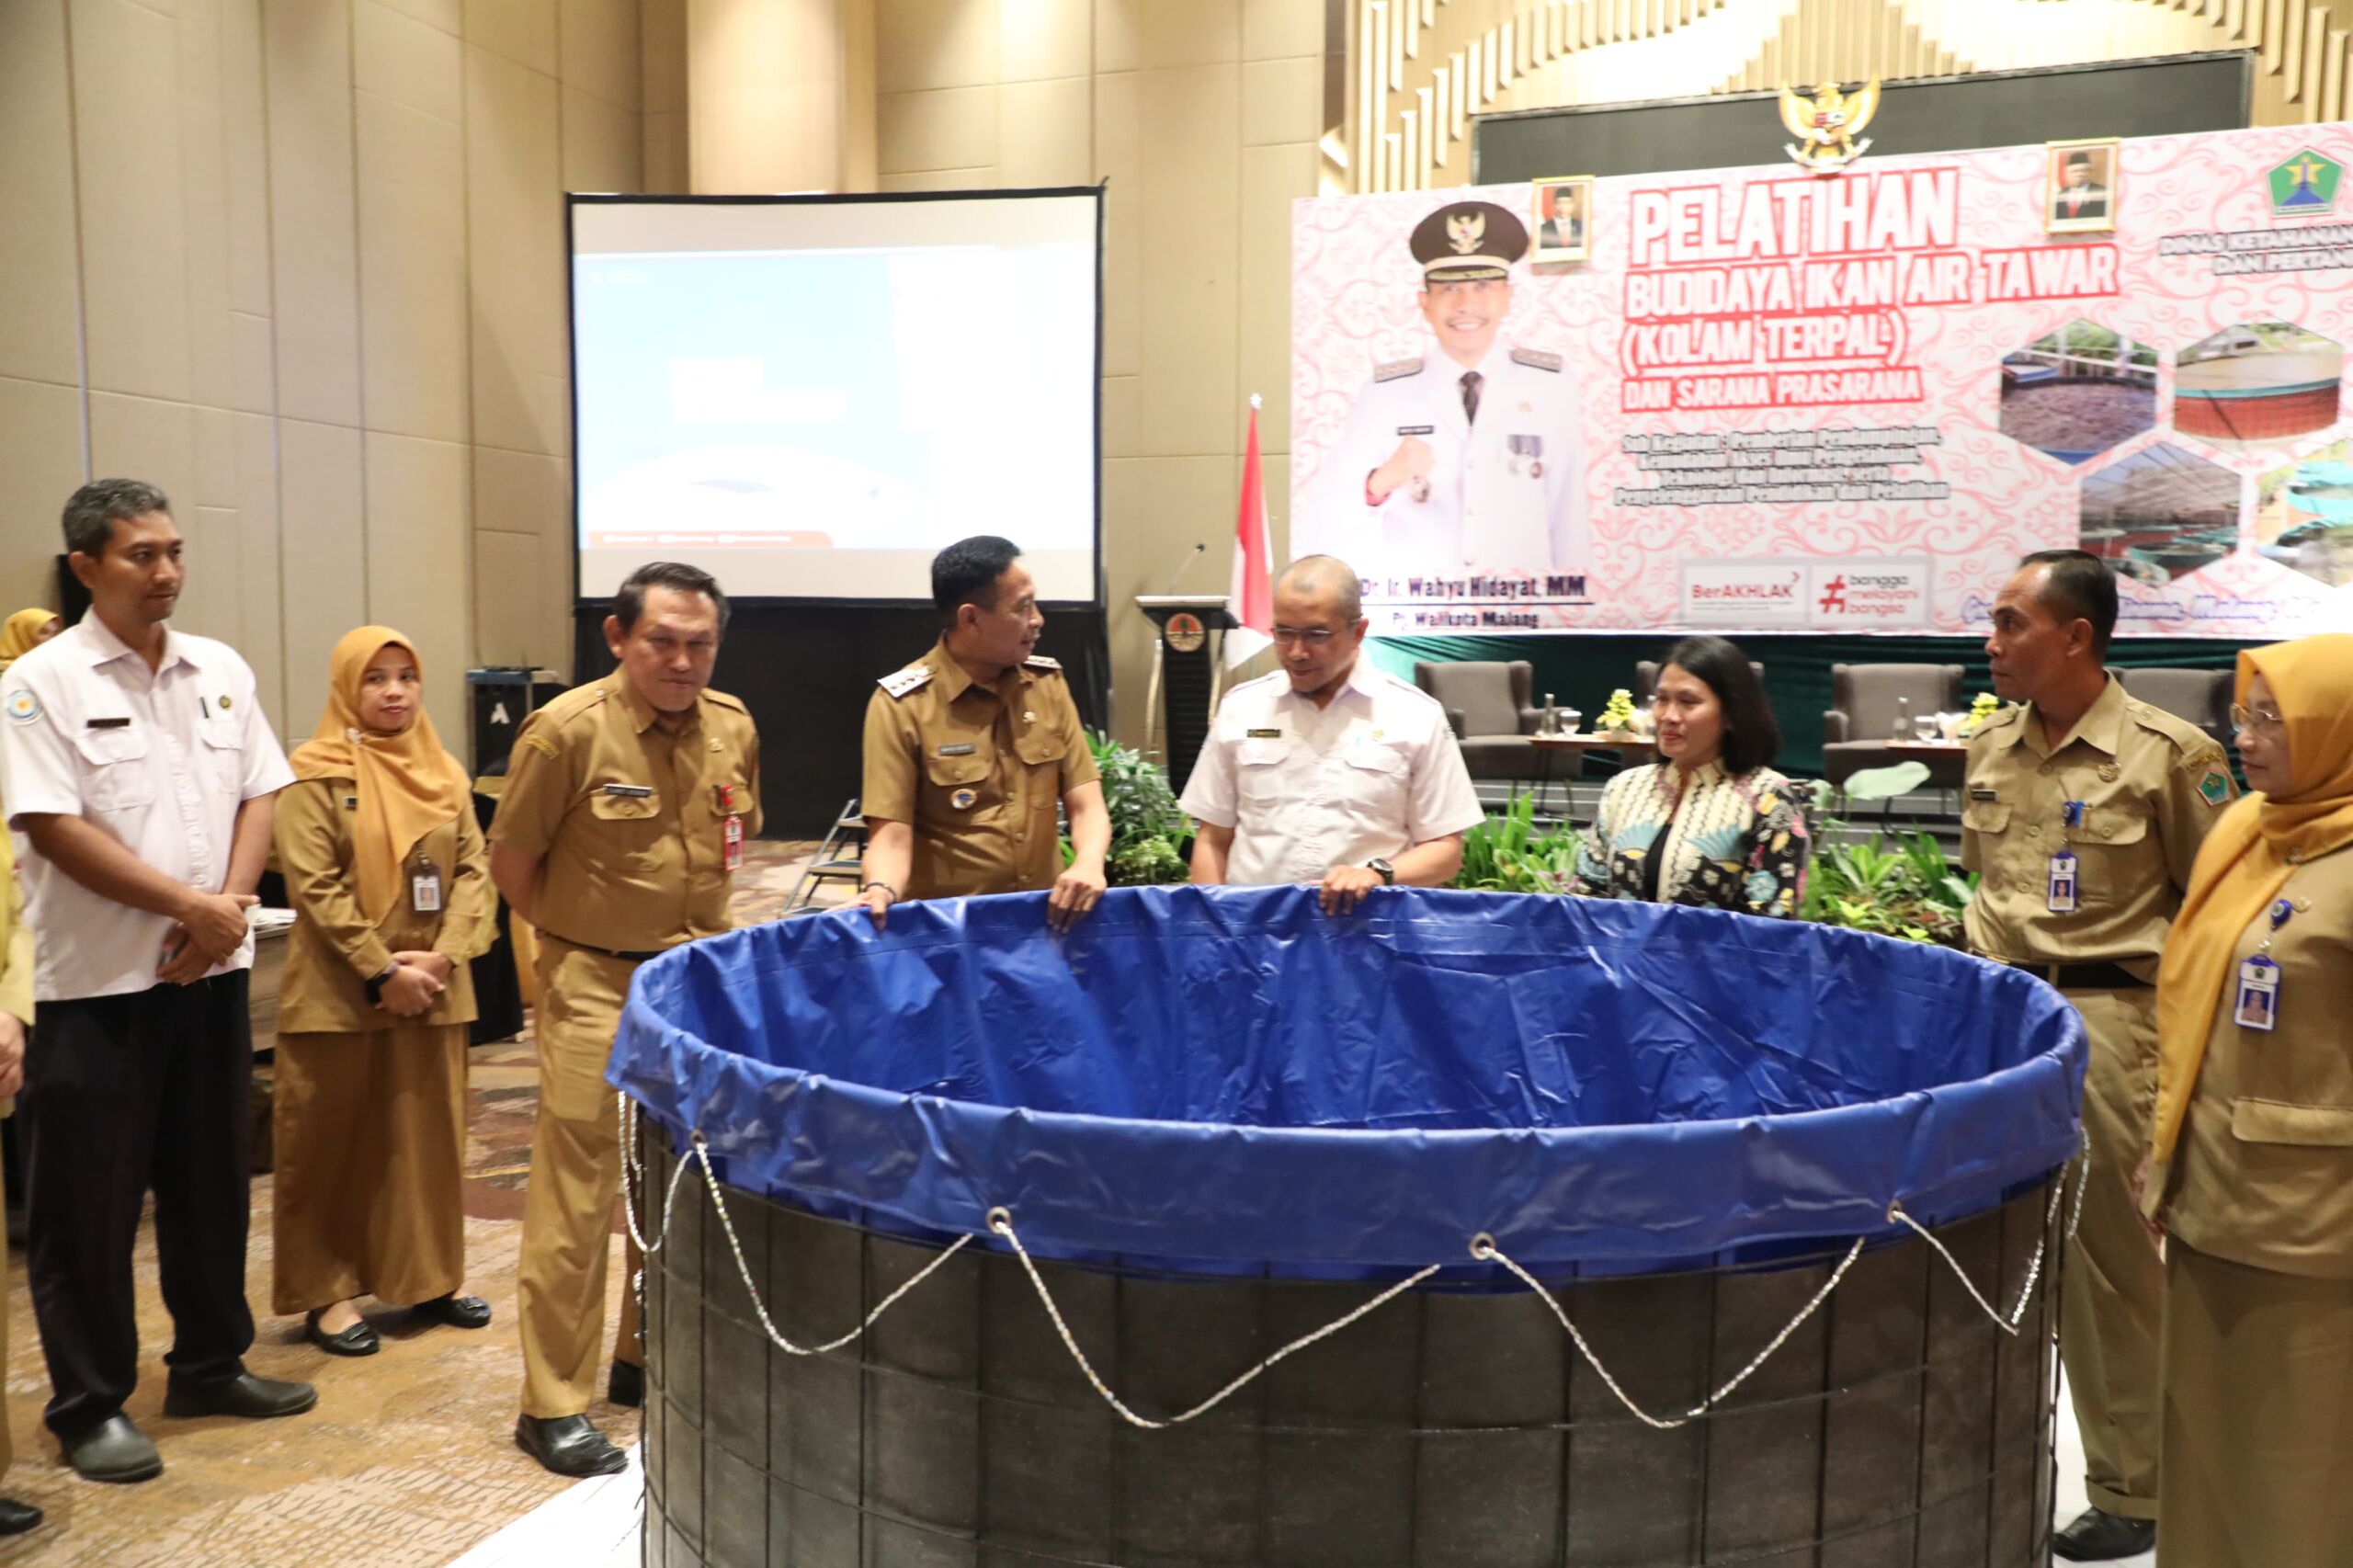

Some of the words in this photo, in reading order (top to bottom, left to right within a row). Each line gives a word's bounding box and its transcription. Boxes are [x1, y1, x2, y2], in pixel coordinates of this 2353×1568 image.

[1630, 166, 1960, 267] PELATIHAN
[1625, 262, 1793, 321] BUDIDAYA
[1802, 256, 1897, 312] IKAN
[1903, 251, 1972, 306] AIR
[1981, 243, 2119, 302] TAWAR
[1620, 318, 1754, 378] (KOLAM
[1763, 304, 1907, 368] TERPAL)
[1622, 377, 1673, 413] DAN
[1675, 372, 1772, 410] SARANA
[1773, 366, 1923, 406] PRASARANA
[1408, 577, 1465, 600] Wahyu
[1547, 575, 1586, 597] MM
[1691, 585, 1793, 597] BerAKHLAK
[1849, 574, 1909, 588] bangga
[1415, 611, 1478, 627] Walikota
[1483, 611, 1539, 630] Malang
[1848, 602, 1905, 617] bangsa
